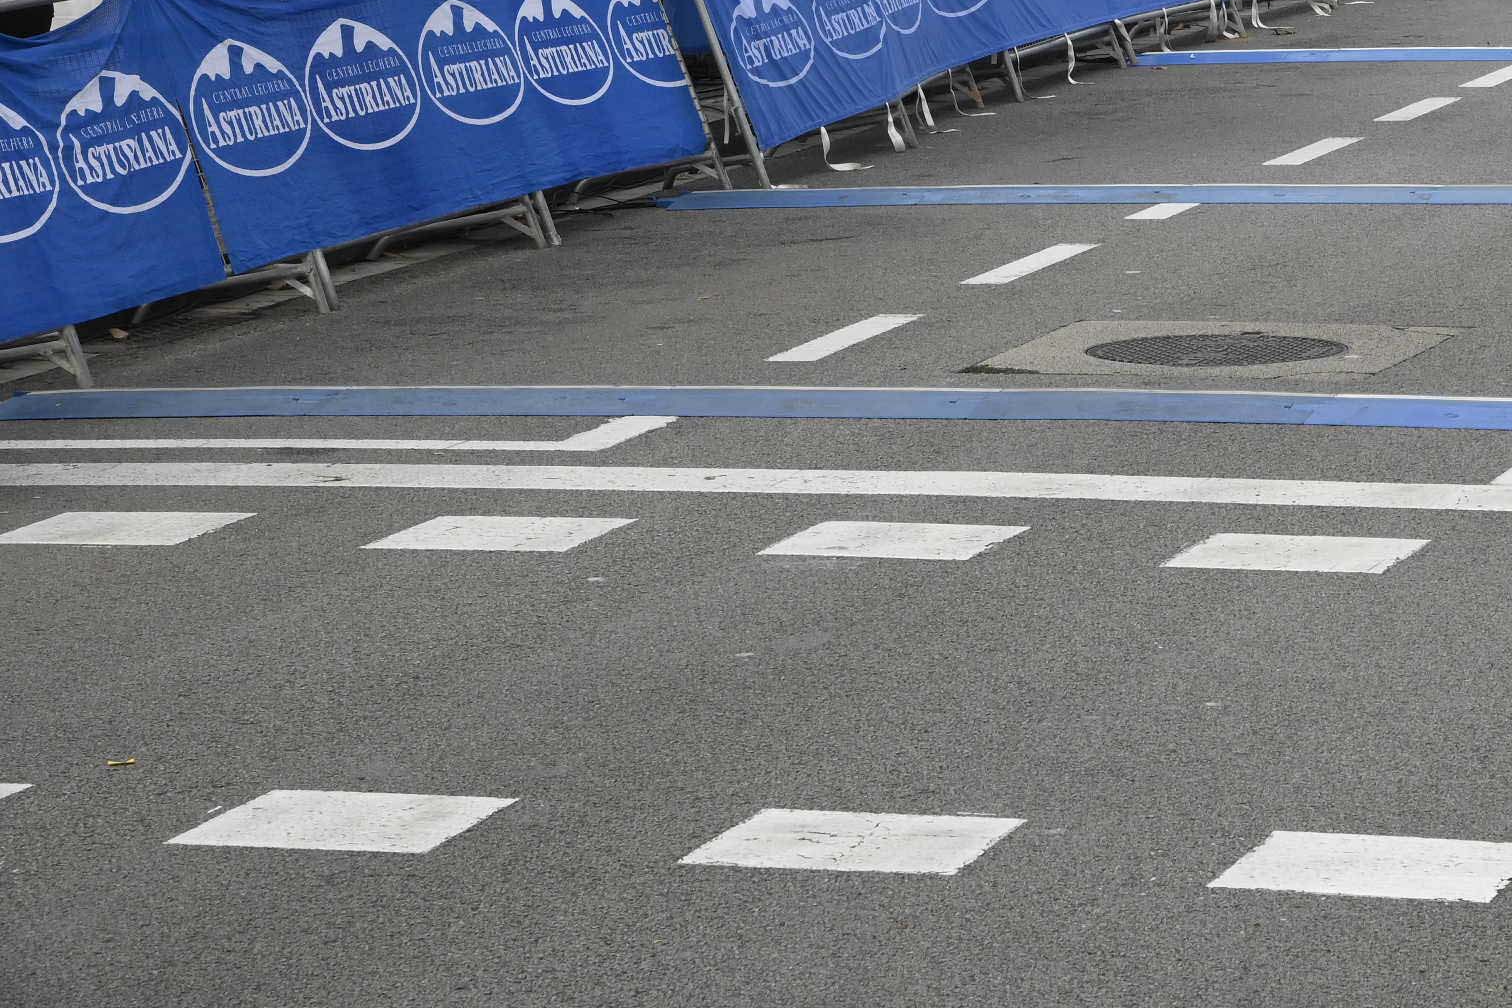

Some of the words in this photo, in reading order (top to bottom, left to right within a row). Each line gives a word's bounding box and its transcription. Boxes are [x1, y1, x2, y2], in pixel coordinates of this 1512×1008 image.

[438, 43, 471, 58] CENTRAL
[473, 37, 504, 53] LECHERA
[531, 28, 561, 42] CENTRAL
[562, 23, 592, 37] LECHERA
[617, 20, 678, 63] ASTUR
[327, 64, 361, 81] CENTRAL
[362, 55, 400, 75] LECHERA
[429, 50, 519, 98] ASTURIANA
[524, 35, 608, 80] ASTURIANA
[213, 86, 251, 104] CENTRAL
[254, 78, 289, 97] LECHERA
[316, 74, 415, 124] ASTURIANA
[202, 96, 305, 149] ASTURIANA
